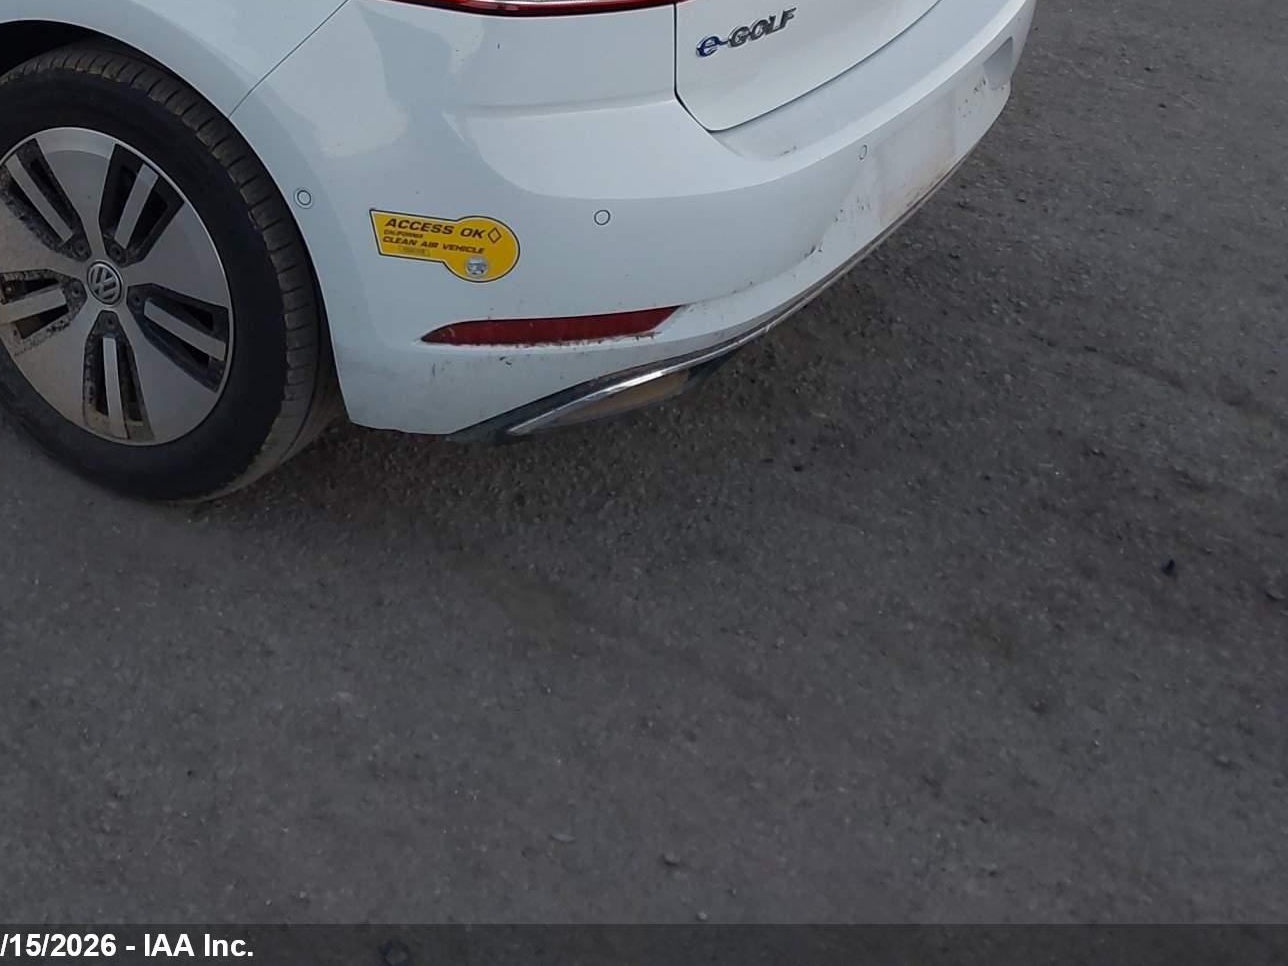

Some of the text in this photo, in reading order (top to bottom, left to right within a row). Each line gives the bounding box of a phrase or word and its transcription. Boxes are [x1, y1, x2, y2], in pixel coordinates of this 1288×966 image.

[696, 7, 797, 57] e-GOLF
[384, 218, 486, 239] ACCESS OK
[382, 236, 418, 247] CLEAN
[420, 241, 439, 249] AIR
[442, 243, 485, 255] VEHICLE
